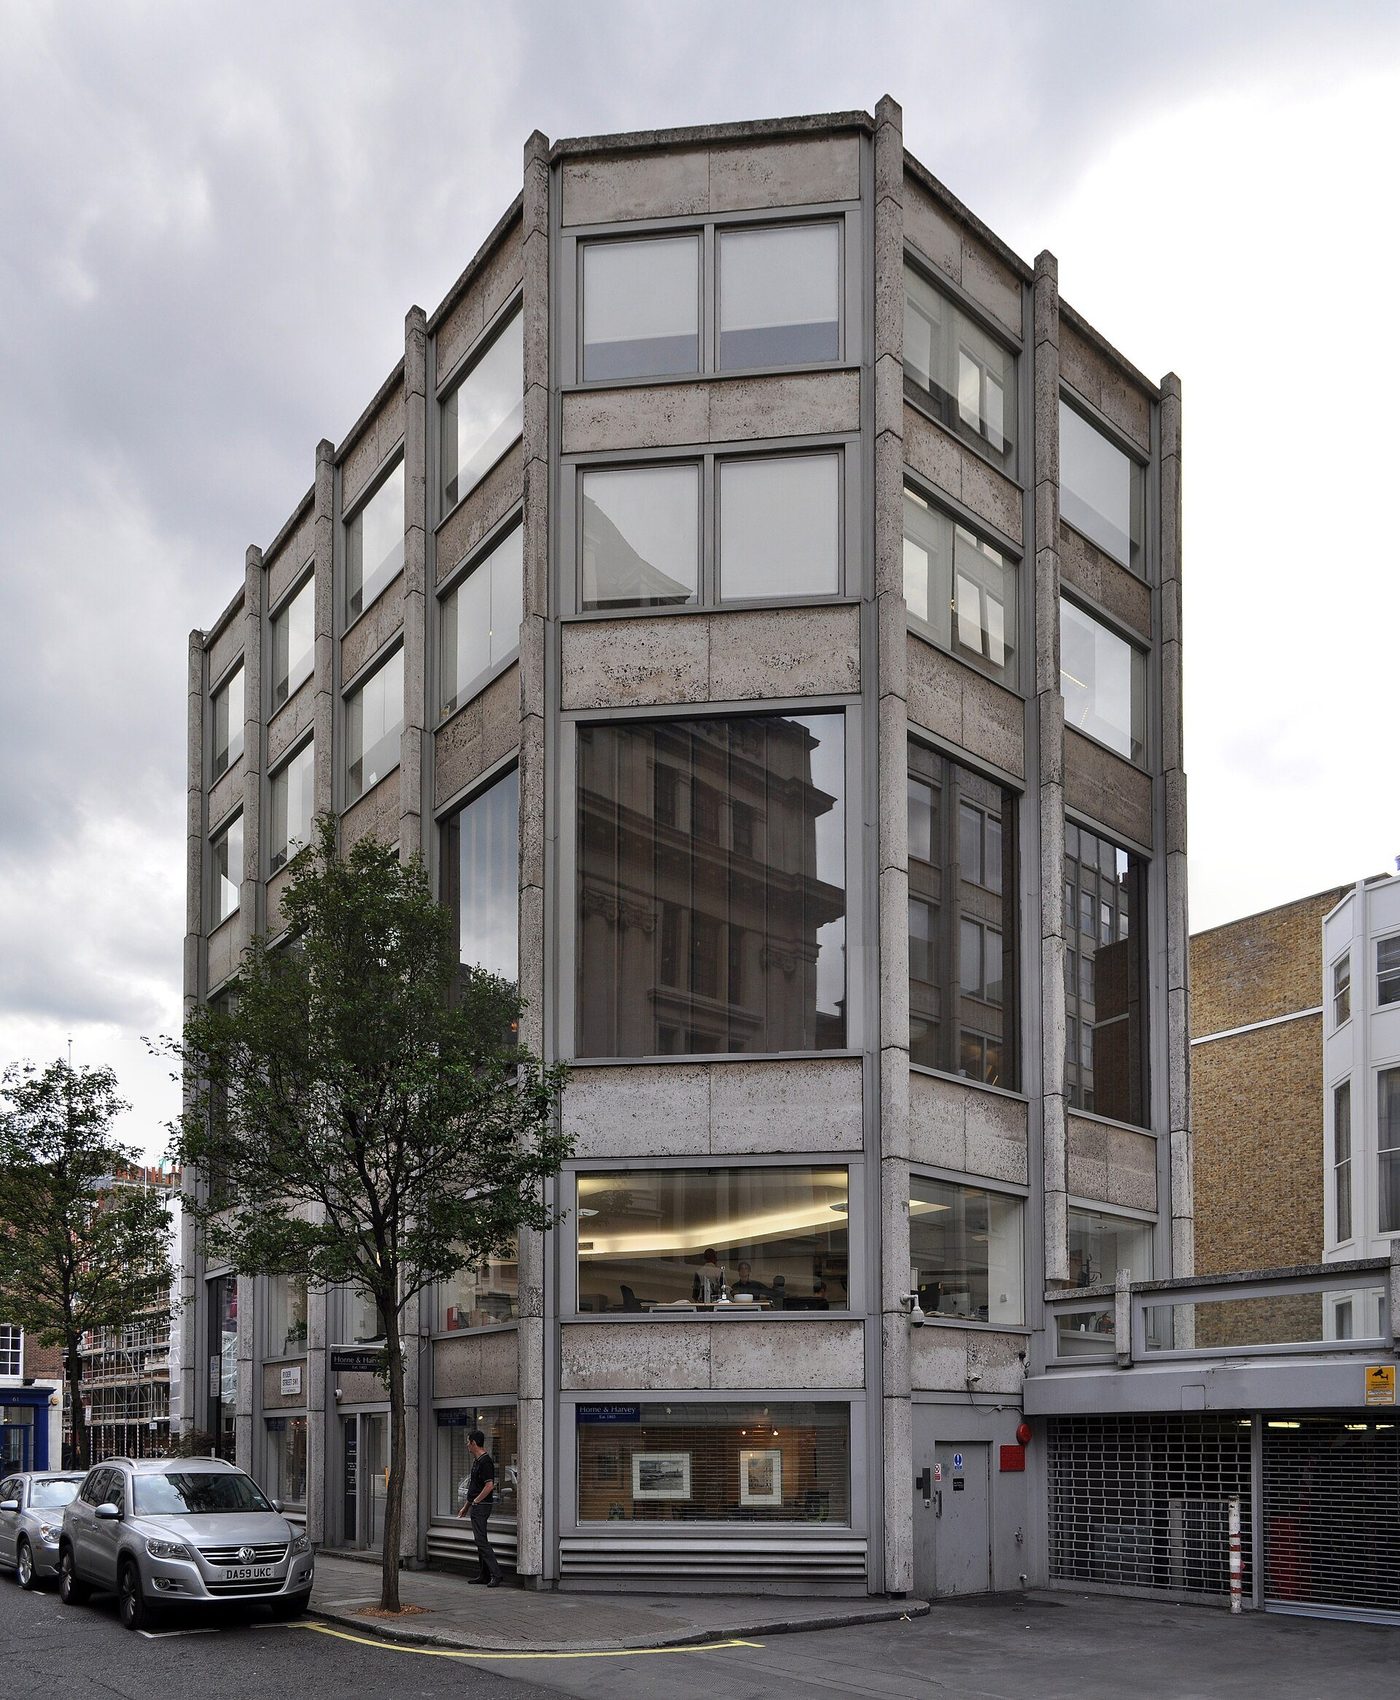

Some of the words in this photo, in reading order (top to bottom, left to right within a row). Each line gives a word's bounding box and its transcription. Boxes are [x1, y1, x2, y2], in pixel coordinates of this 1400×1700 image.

[282, 1378, 292, 1387] STREET
[611, 1406, 636, 1415] Harvey
[226, 1569, 252, 1580] DA59
[254, 1567, 272, 1578] UKC
